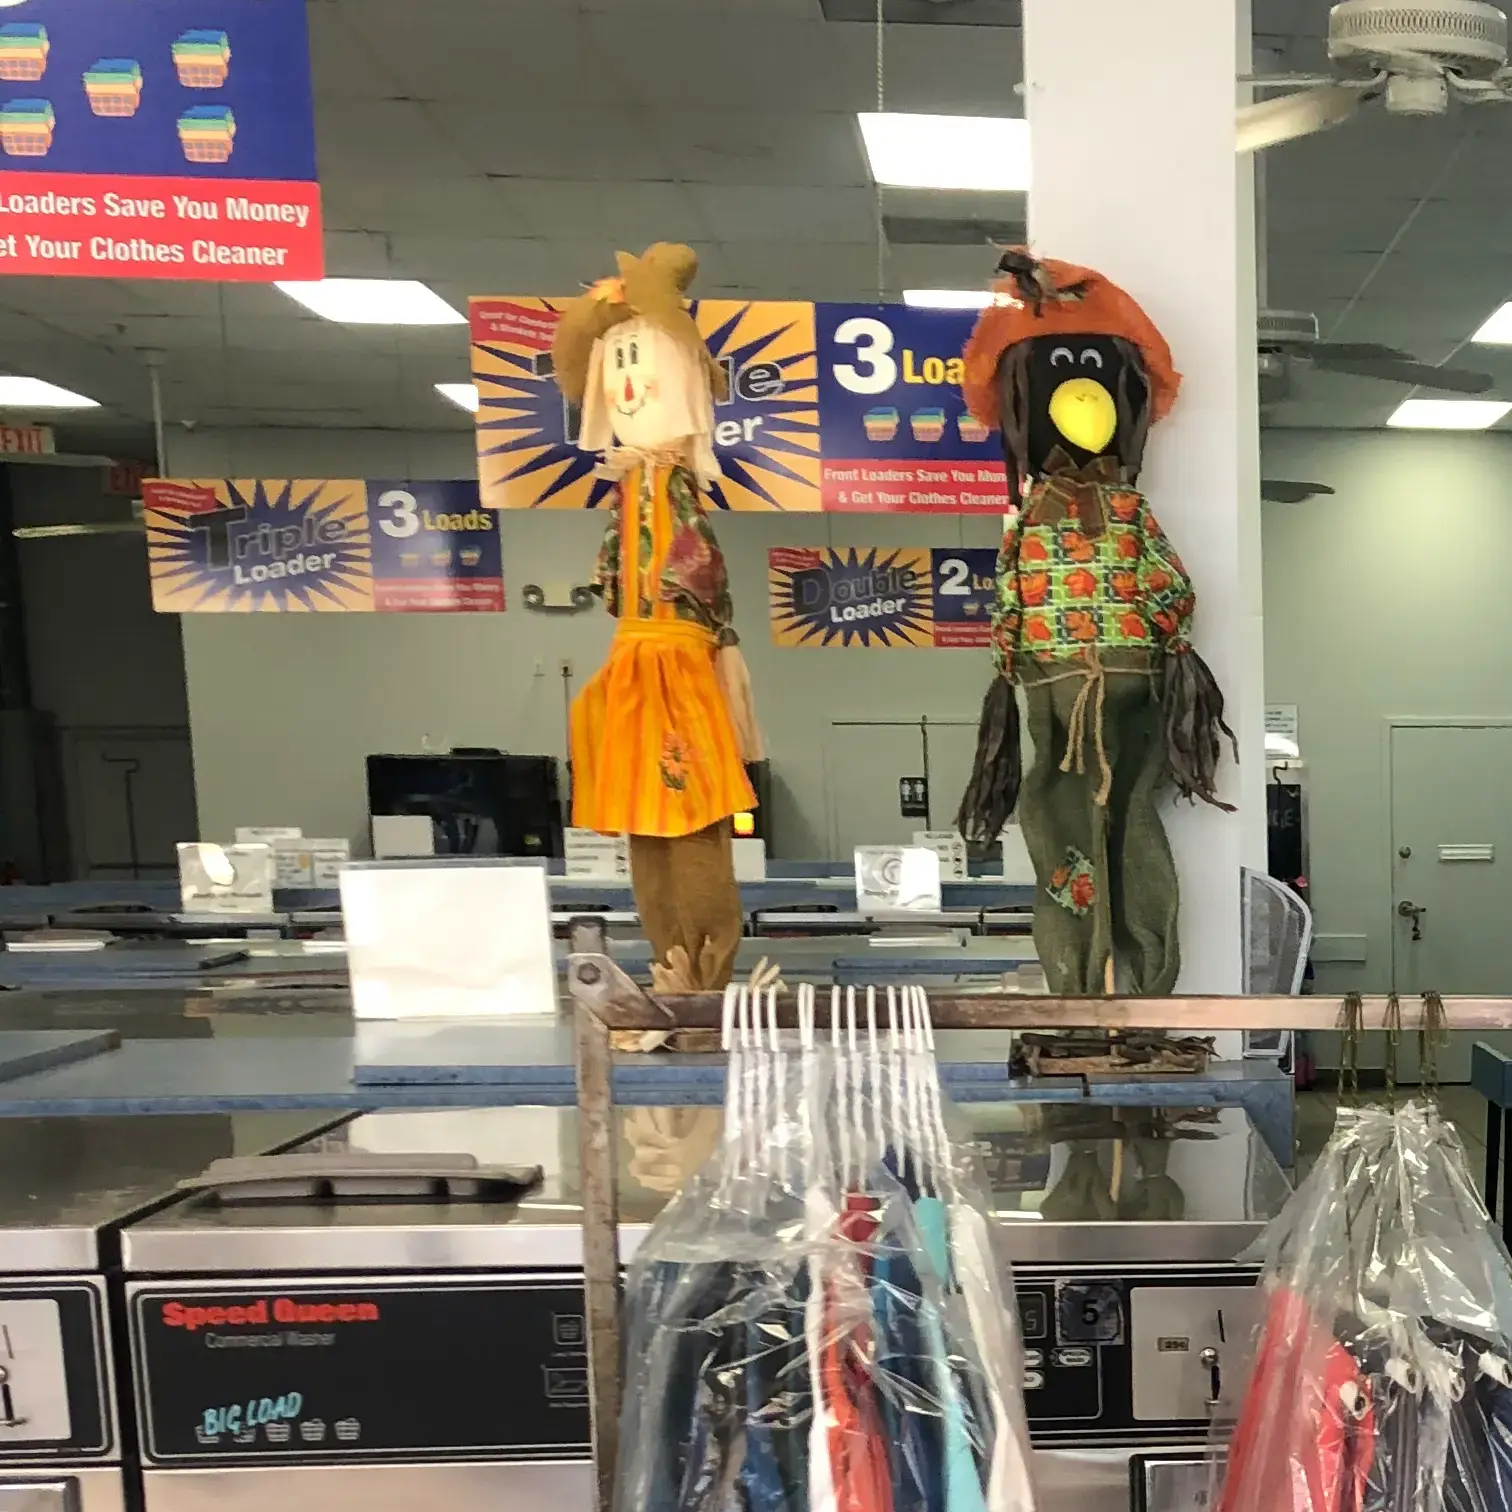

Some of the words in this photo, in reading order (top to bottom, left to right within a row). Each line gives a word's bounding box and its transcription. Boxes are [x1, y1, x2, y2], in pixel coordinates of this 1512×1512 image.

[0, 190, 97, 217] Loaders
[103, 192, 166, 219] Save
[172, 194, 219, 221] You
[226, 196, 310, 228] Money
[0, 234, 19, 258] et
[24, 233, 82, 259] Your
[90, 236, 185, 263] Clothes
[191, 239, 288, 266] Cleaner
[832, 317, 898, 395] 3
[901, 349, 966, 386] Loa
[823, 467, 859, 481] Front
[862, 467, 914, 482] Loaders
[916, 467, 948, 482] Save
[950, 467, 975, 482] You
[977, 468, 1008, 482] Mon
[378, 489, 420, 538] 3
[421, 508, 494, 532] Loads
[838, 491, 847, 504] &
[851, 491, 873, 504] Get
[876, 491, 905, 505] Your
[908, 491, 957, 505] Clothes
[188, 504, 349, 572] Triple
[233, 552, 337, 586] Loader
[938, 558, 972, 596] 2
[791, 566, 918, 617] Double
[829, 597, 907, 624] Loader
[161, 1299, 270, 1332] Speed
[272, 1297, 380, 1323] Queen
[1081, 1299, 1100, 1326] 5
[204, 1332, 283, 1349] Commercial
[202, 1404, 242, 1436] BIG
[246, 1391, 304, 1427] LOAD
